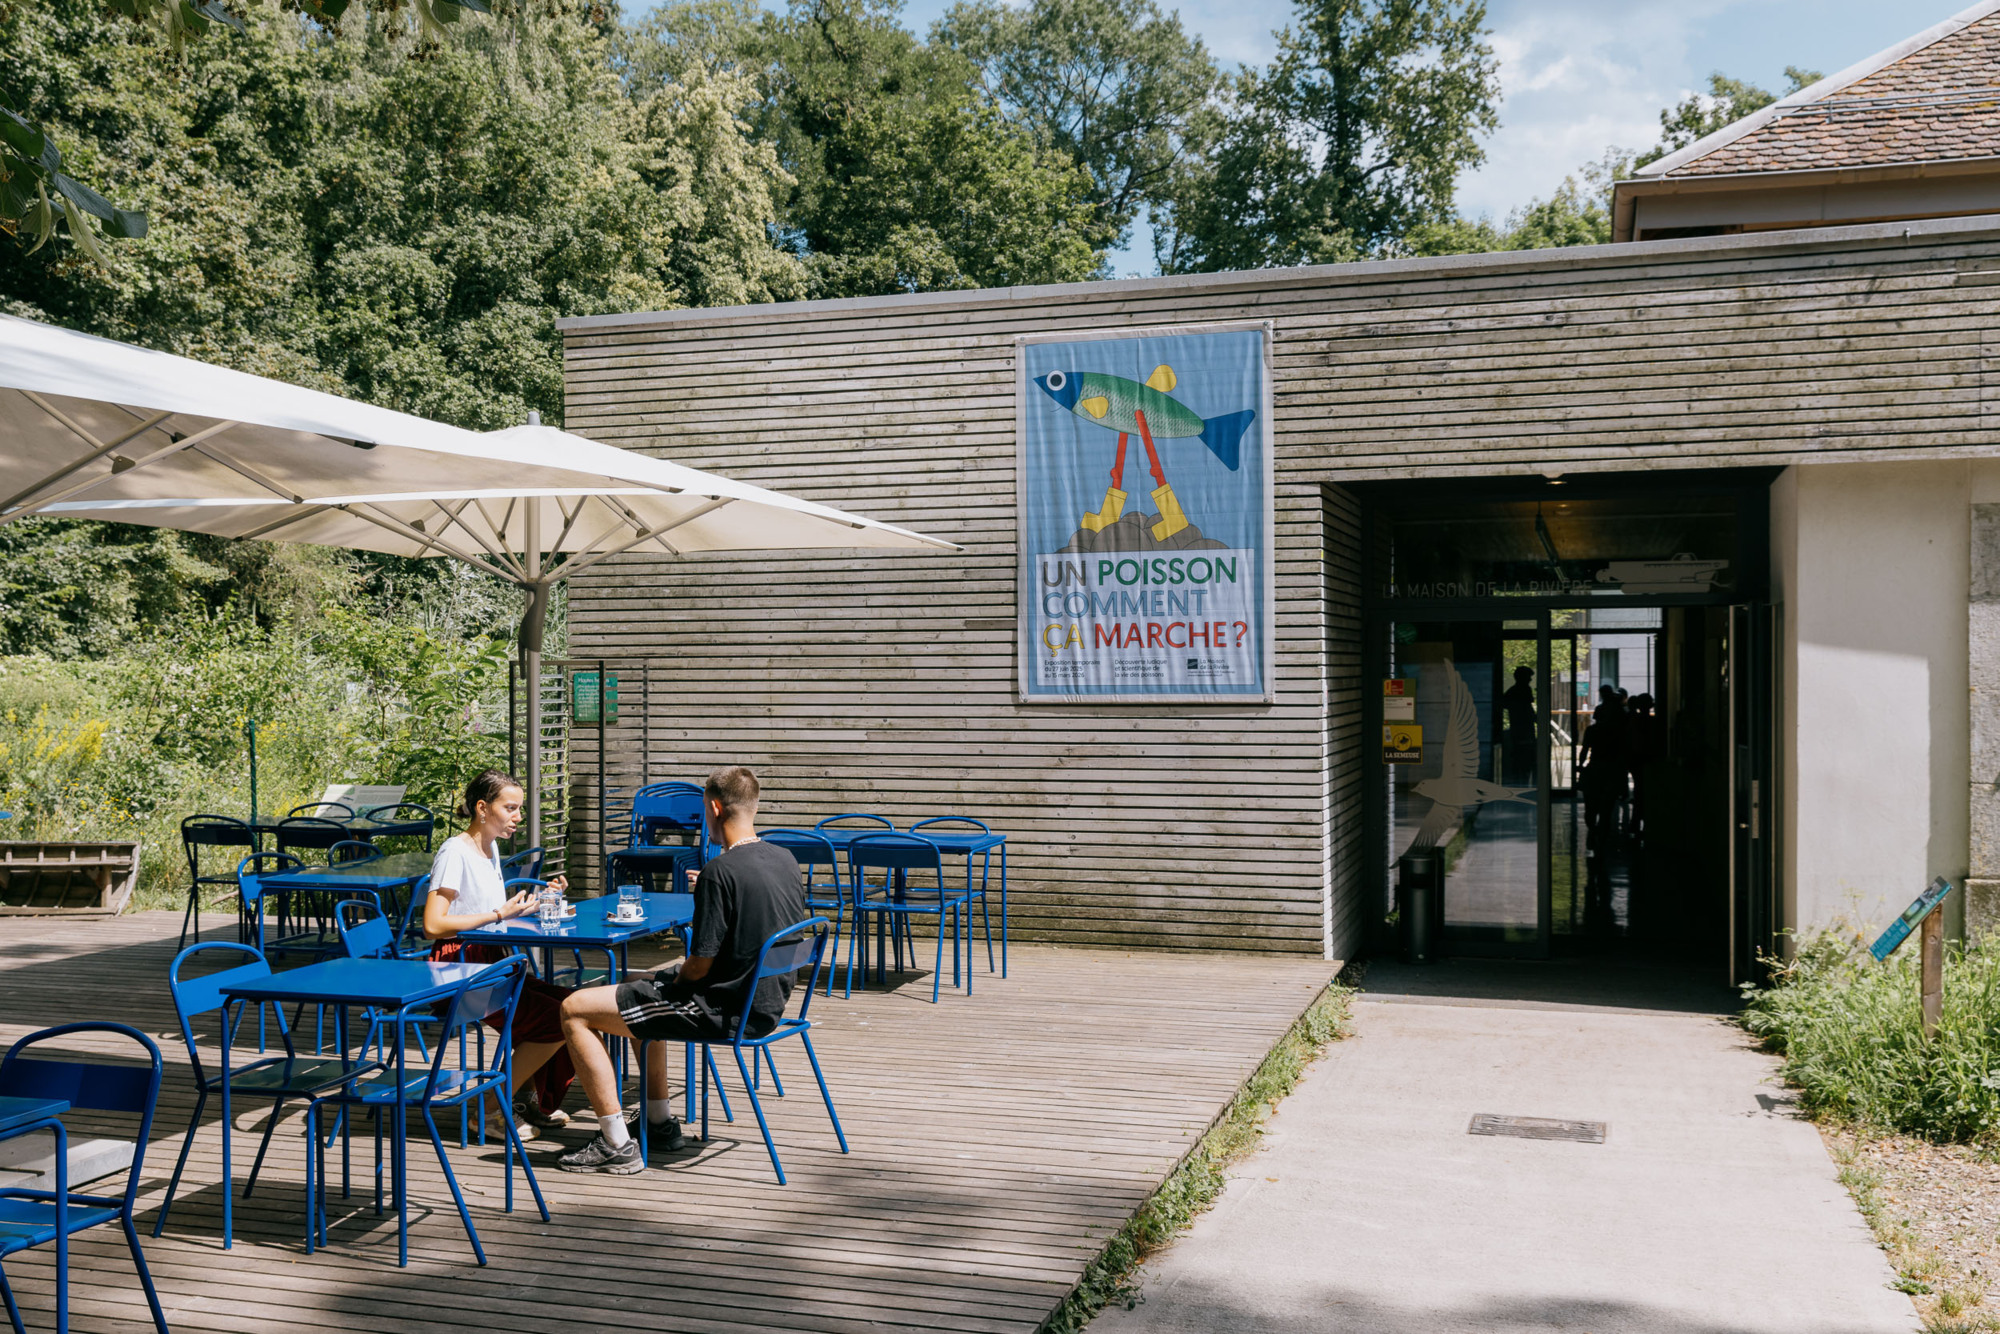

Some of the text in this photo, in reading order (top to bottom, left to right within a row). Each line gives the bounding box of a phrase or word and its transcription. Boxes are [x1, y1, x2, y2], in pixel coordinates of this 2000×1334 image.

[1042, 556, 1237, 587] UN POISSON
[1042, 589, 1208, 619] COMMENT
[1382, 583, 1401, 599] LA
[1407, 582, 1469, 599] MAISON
[1475, 581, 1497, 598] DE
[1042, 623, 1086, 657] ÇA
[1147, 658, 1168, 666] ludique
